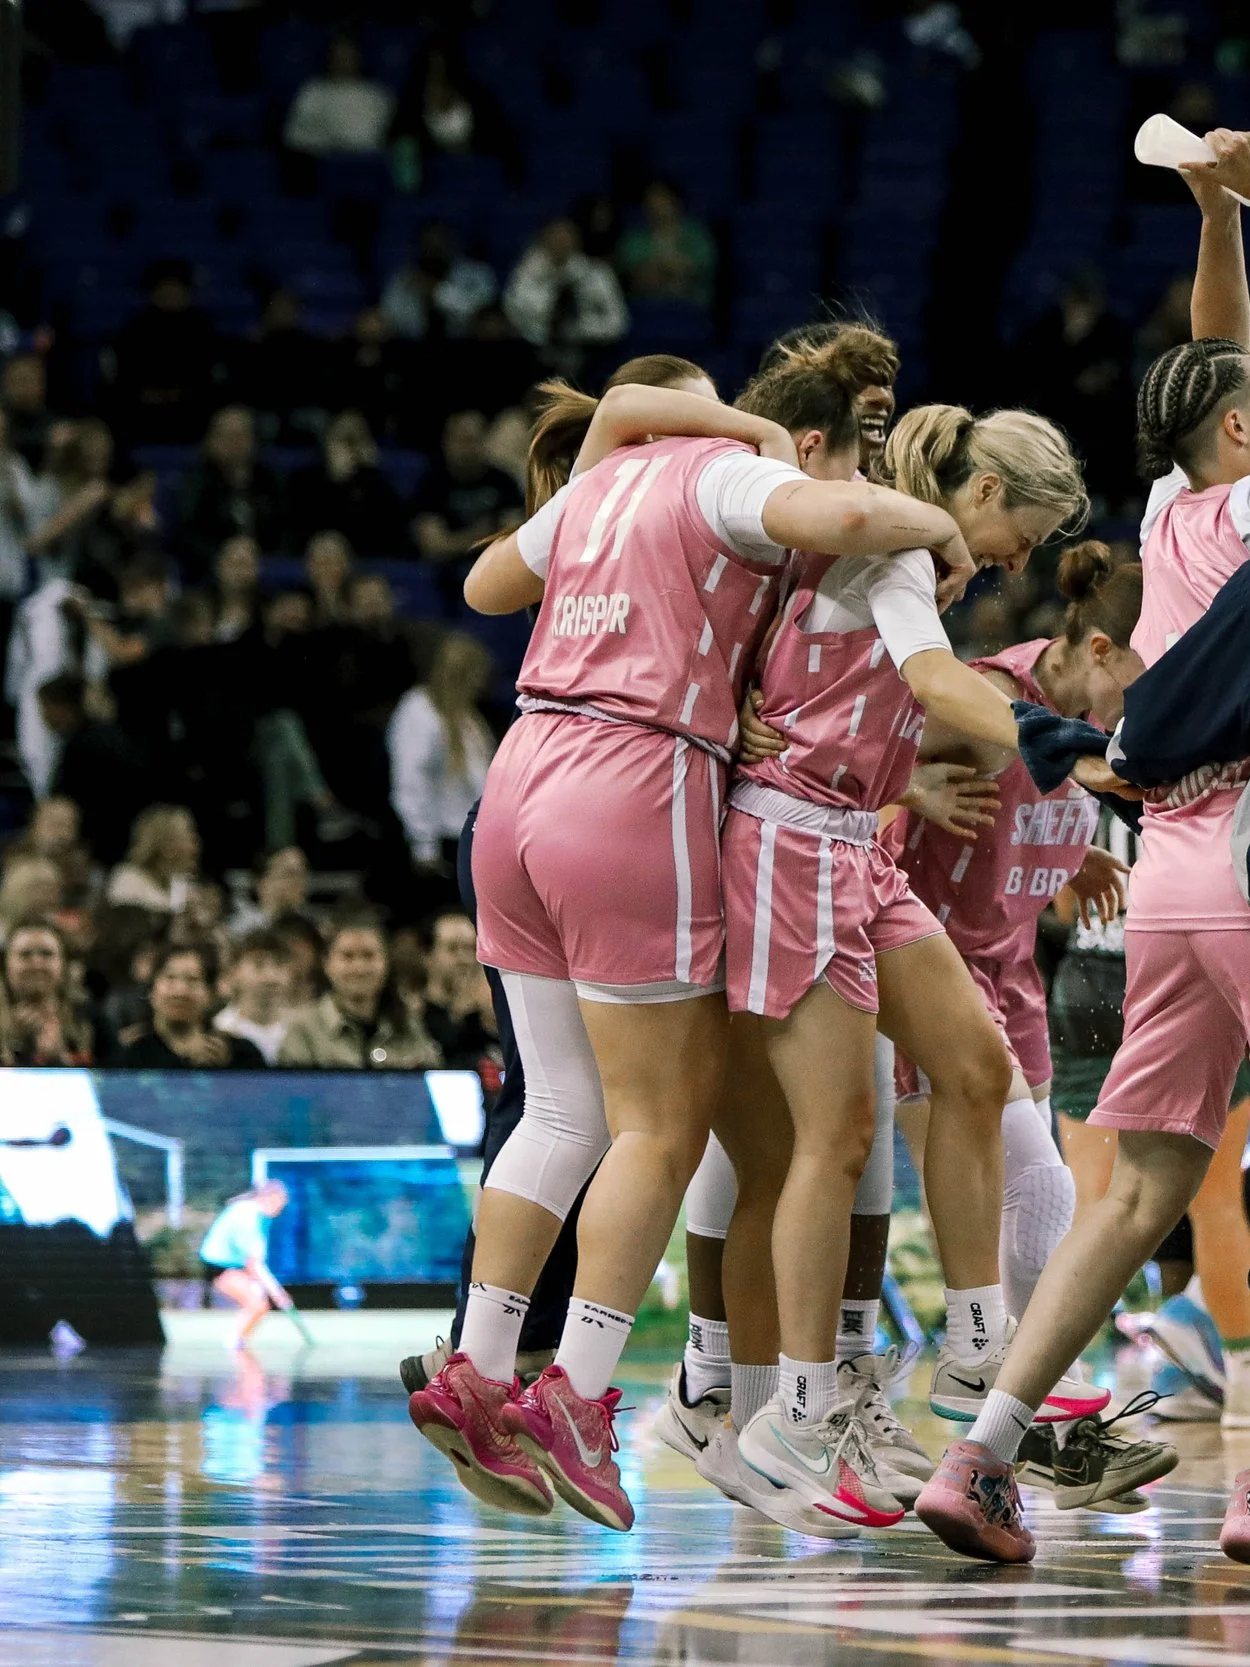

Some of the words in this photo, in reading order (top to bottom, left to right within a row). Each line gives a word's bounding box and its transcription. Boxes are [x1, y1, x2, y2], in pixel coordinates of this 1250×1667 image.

[579, 454, 673, 562] 11
[551, 592, 630, 636] KRISPR
[1029, 867, 1069, 897] BR
[970, 1302, 986, 1334] CRAFT
[796, 1375, 807, 1408] CRAFT
